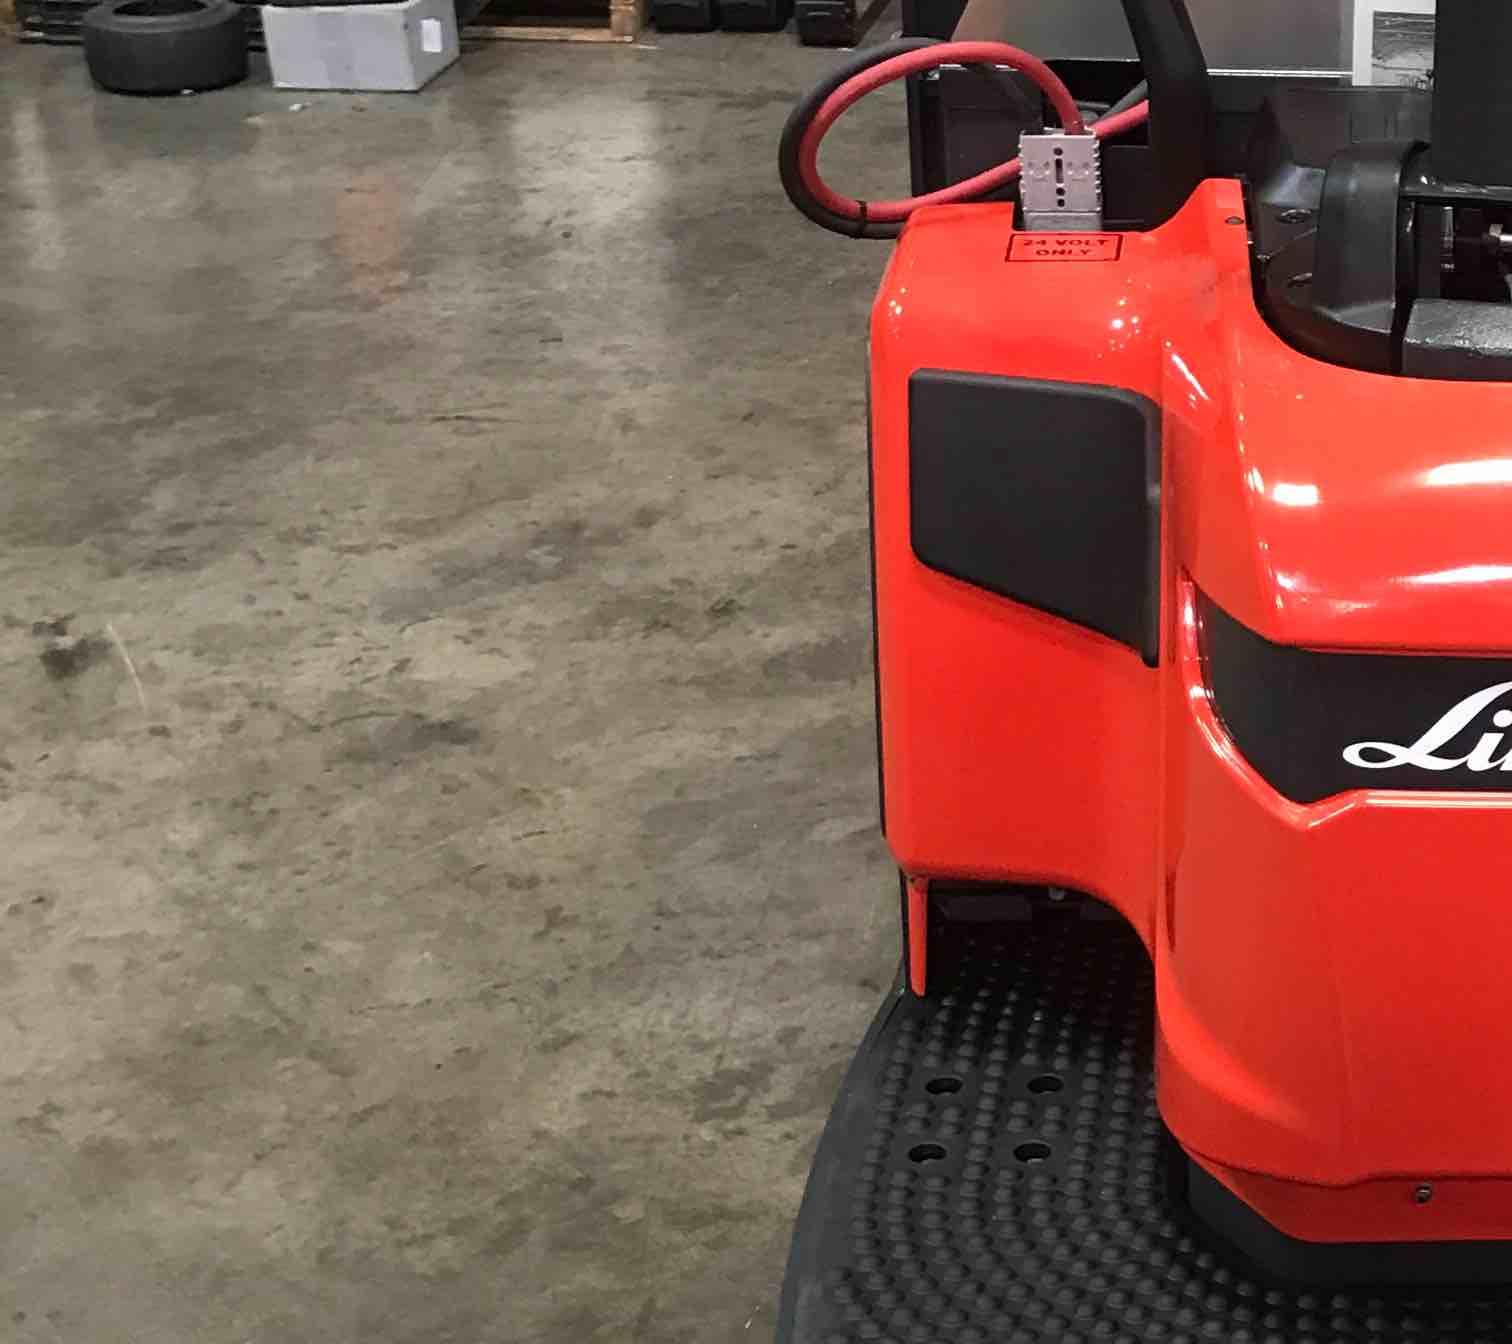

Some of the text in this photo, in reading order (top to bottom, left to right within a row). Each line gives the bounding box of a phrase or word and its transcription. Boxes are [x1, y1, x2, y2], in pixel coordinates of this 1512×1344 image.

[1023, 239, 1110, 247] 24 VOLT
[1035, 248, 1093, 257] ONLY
